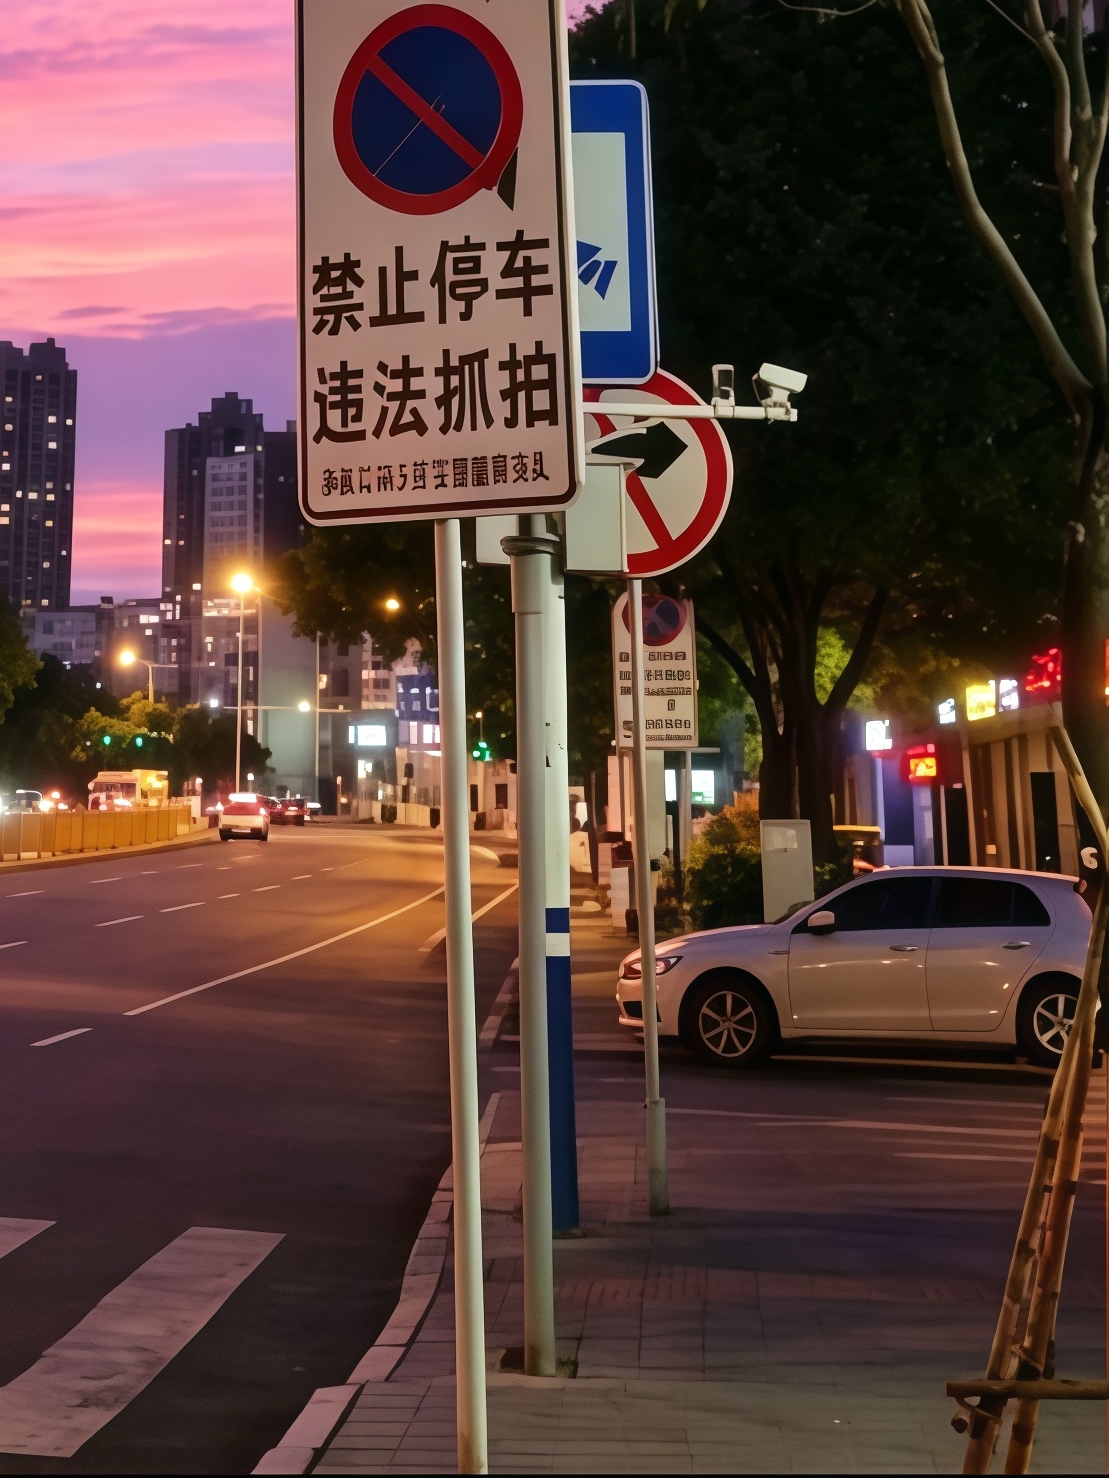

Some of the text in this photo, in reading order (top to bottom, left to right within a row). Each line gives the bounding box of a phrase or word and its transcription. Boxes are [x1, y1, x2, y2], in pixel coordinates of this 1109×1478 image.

[312, 229, 554, 336] 禁止停车
[312, 340, 559, 445] 违法抓拍
